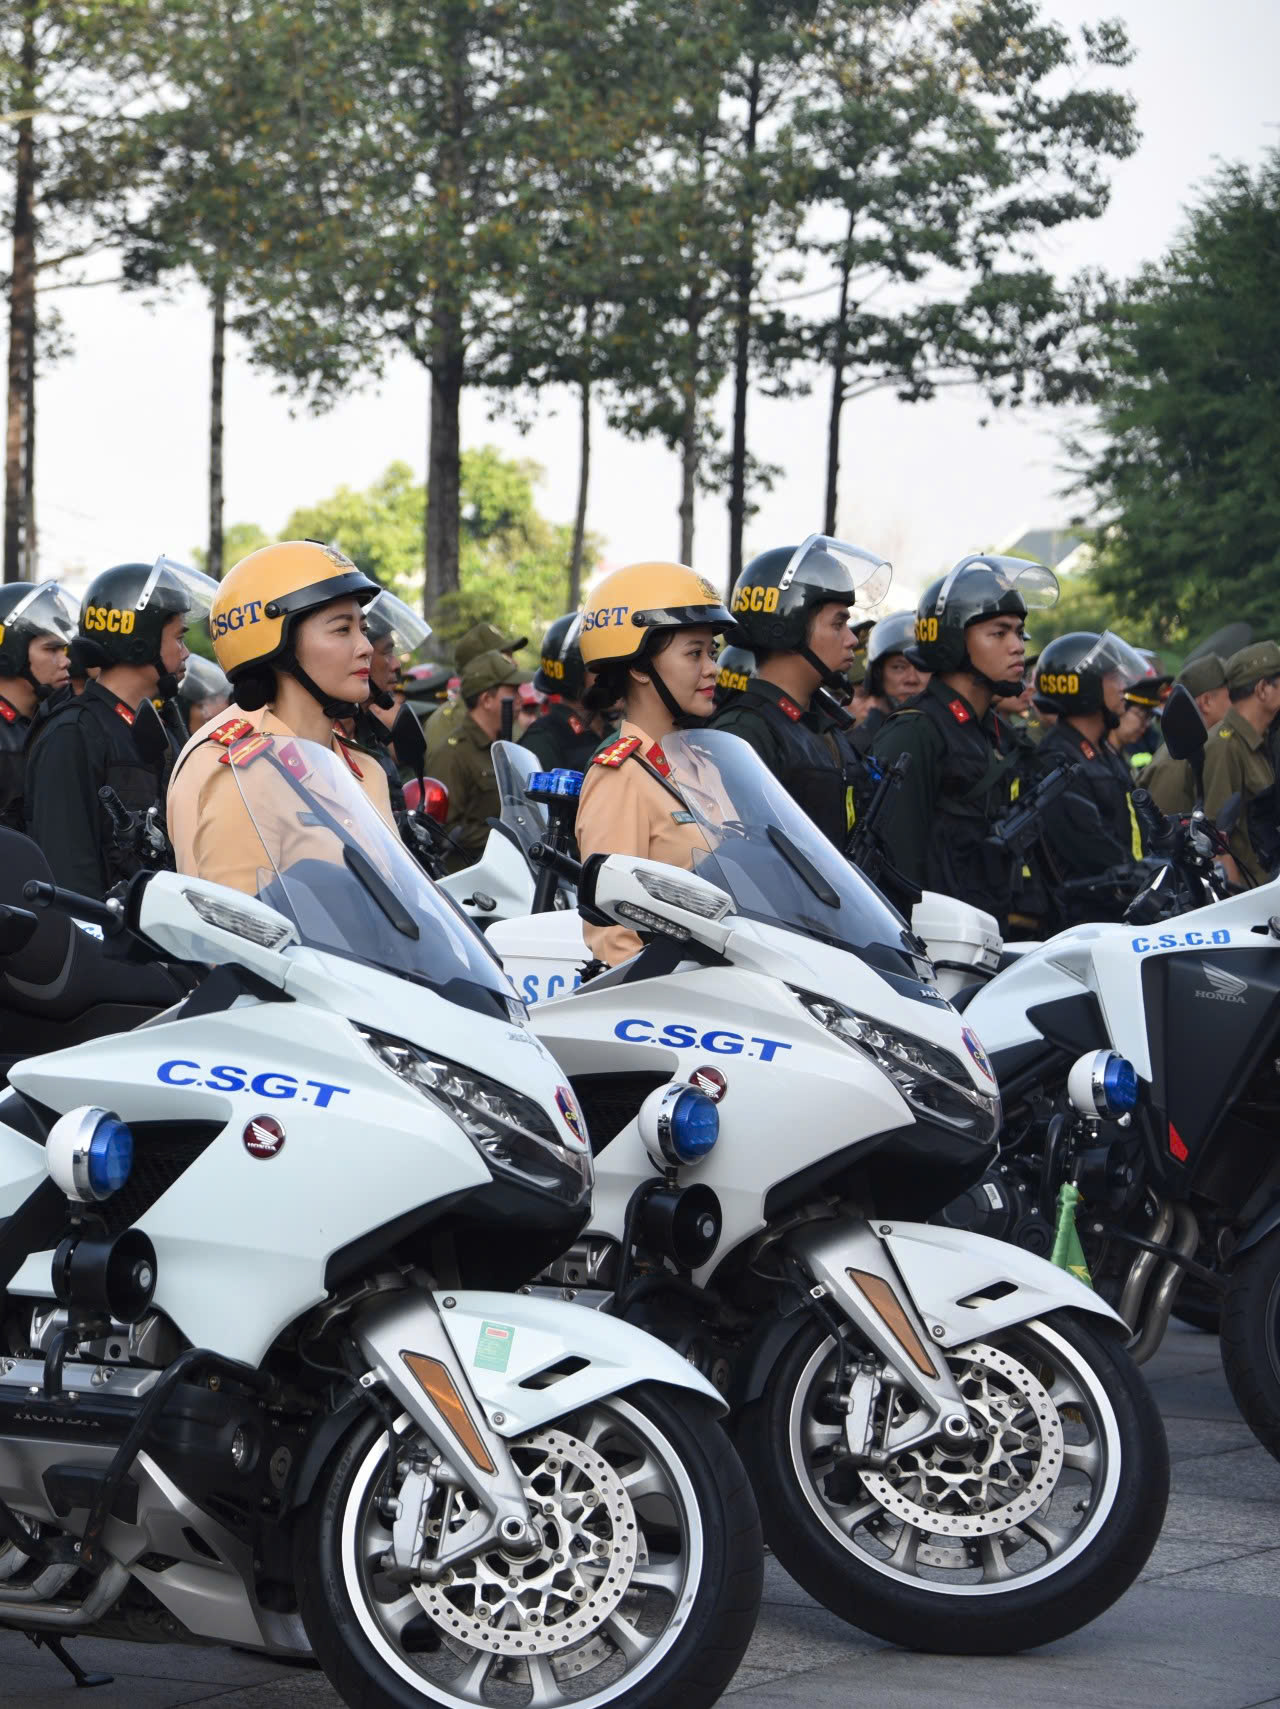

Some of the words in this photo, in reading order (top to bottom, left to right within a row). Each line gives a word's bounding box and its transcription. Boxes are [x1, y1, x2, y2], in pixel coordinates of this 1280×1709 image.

[210, 600, 262, 641] CSGT
[582, 606, 629, 632] SGT
[1194, 990, 1247, 1004] HONDA
[614, 1019, 793, 1062] C.S.G.T
[157, 1059, 351, 1108] C.S.G.T
